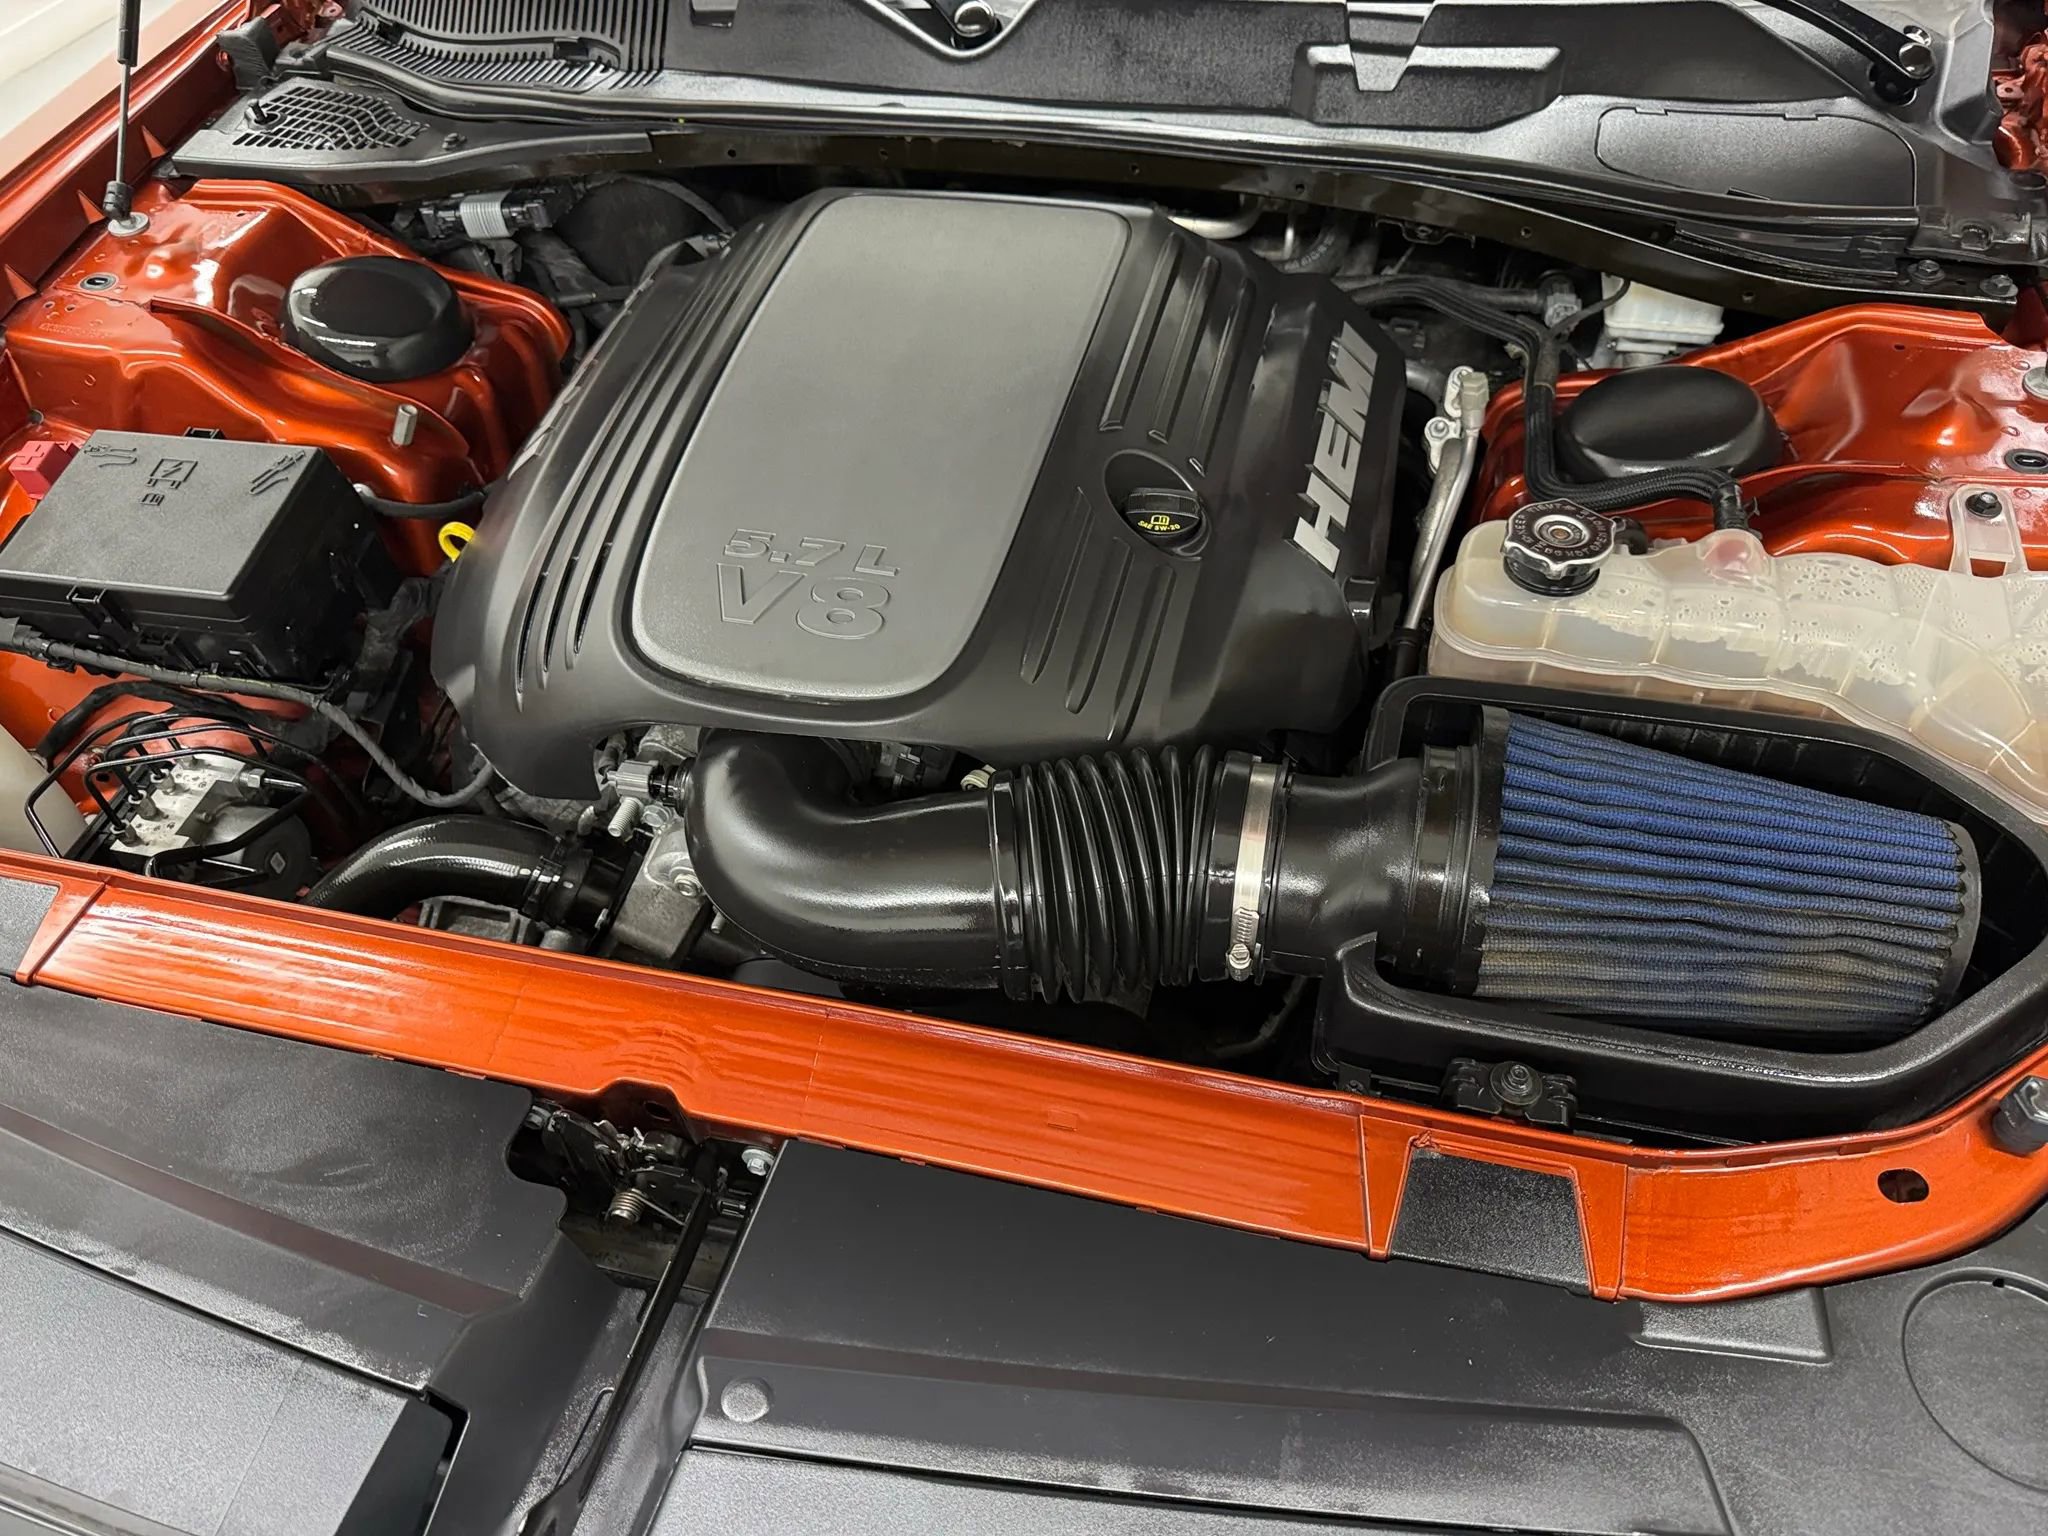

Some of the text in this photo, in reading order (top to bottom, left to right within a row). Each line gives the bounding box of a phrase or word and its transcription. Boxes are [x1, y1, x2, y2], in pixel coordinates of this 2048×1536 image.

[1288, 321, 1378, 575] HEMI
[1544, 547, 1563, 557] DO
[1566, 548, 1590, 557] NOT
[717, 562, 891, 640] V8
